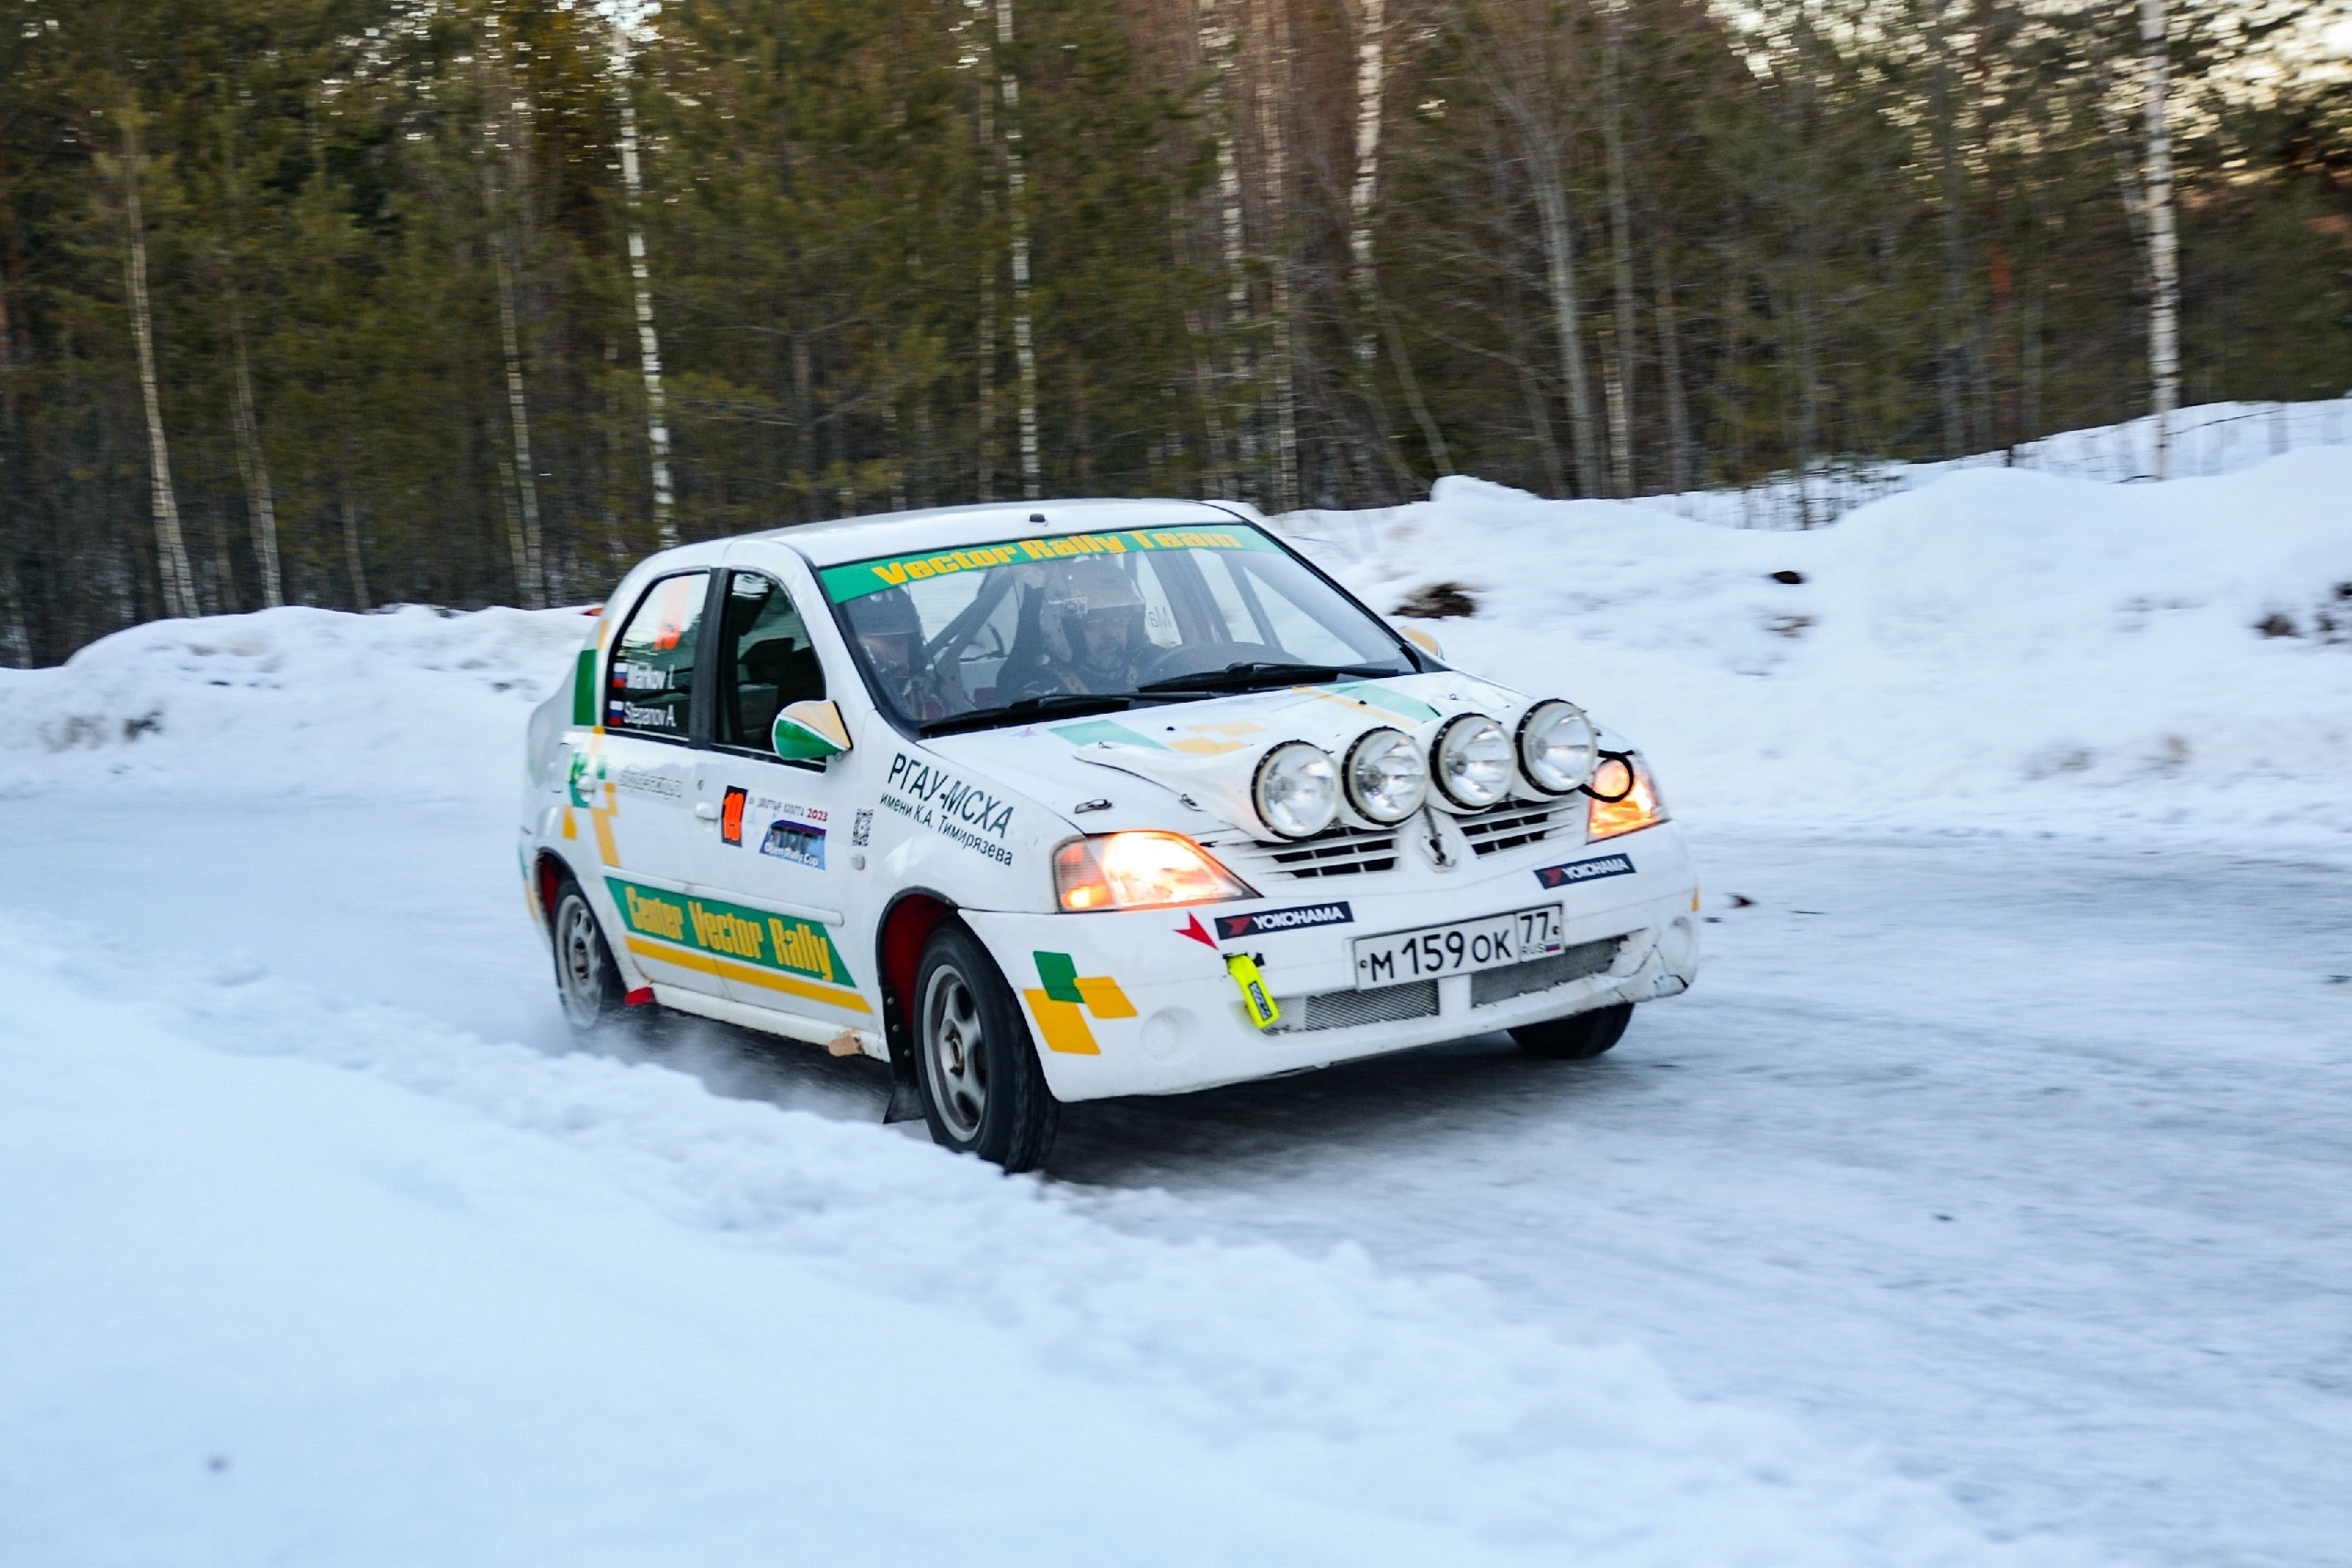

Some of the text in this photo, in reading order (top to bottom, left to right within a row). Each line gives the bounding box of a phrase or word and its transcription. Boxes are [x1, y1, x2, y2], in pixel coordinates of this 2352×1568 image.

[872, 530, 1243, 585] Vector Rally Team
[623, 702, 666, 729] Stepanov
[888, 752, 1013, 839] РГАУ-МСХА
[807, 808, 828, 821] 2023
[879, 793, 1012, 866] имени К.А. Тимирязева
[1562, 858, 1630, 880] YOKOHAMA
[1252, 906, 1345, 930] YOKOHAMA
[1521, 912, 1548, 943] 77
[687, 900, 763, 959] Vector
[768, 917, 833, 982] Rally
